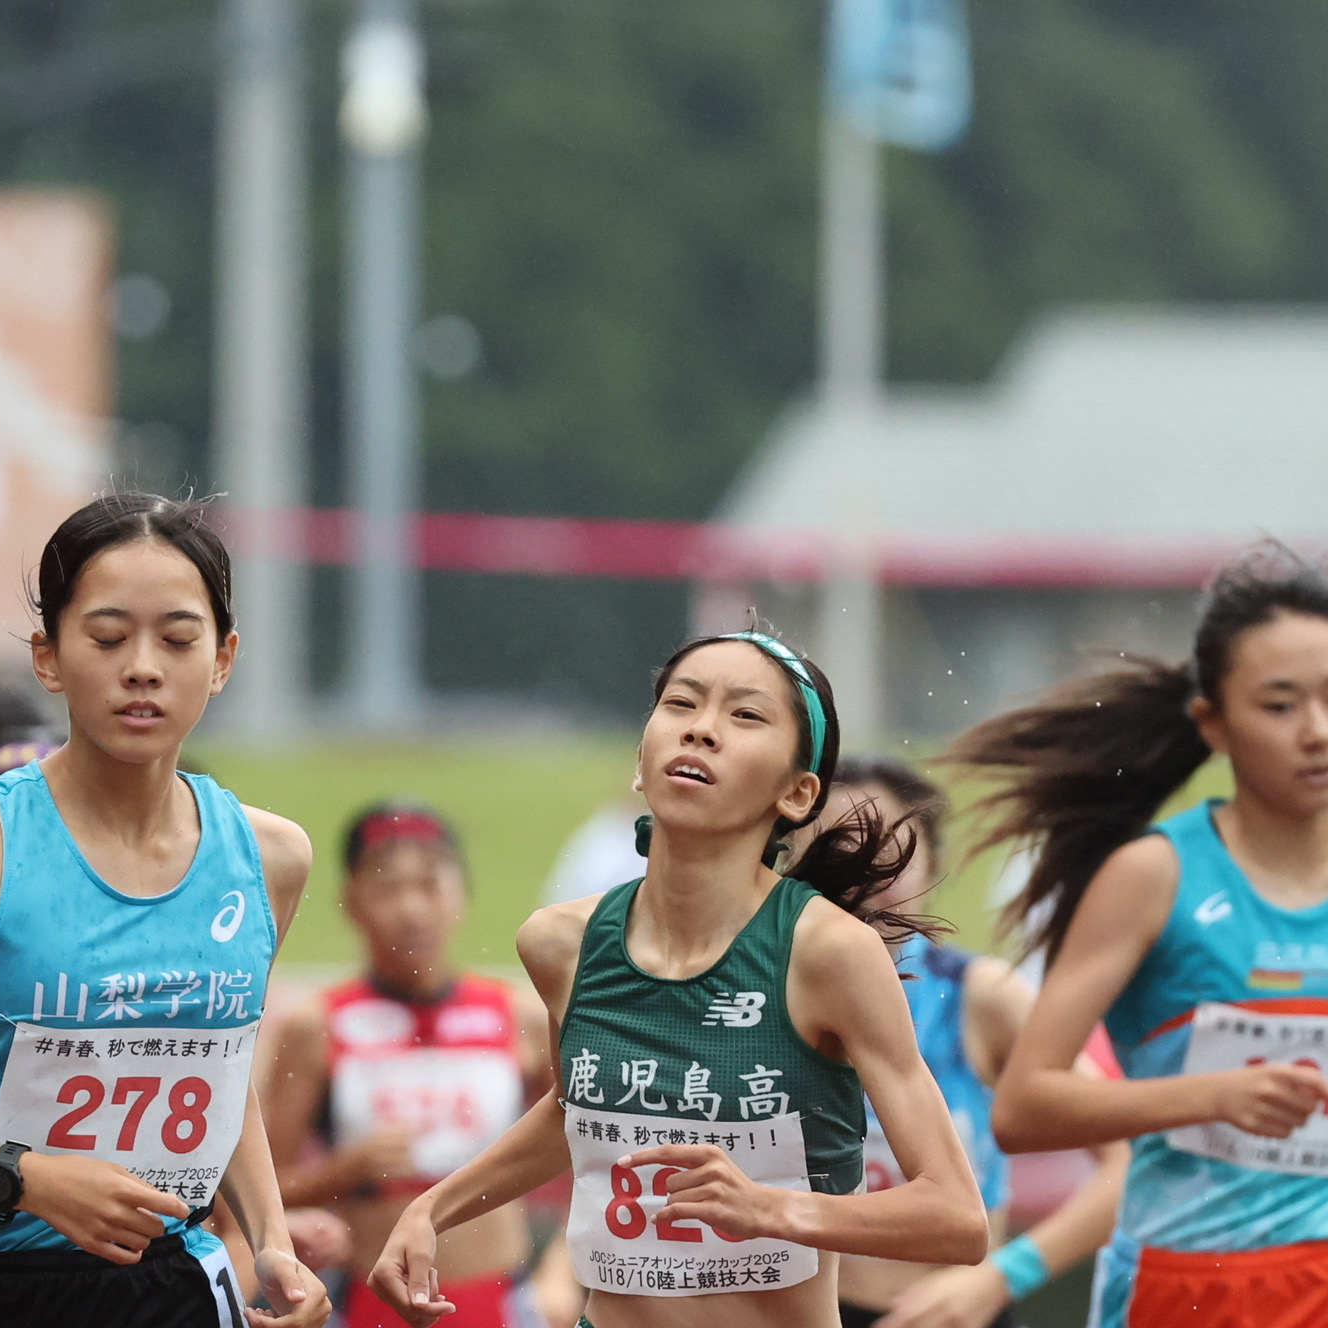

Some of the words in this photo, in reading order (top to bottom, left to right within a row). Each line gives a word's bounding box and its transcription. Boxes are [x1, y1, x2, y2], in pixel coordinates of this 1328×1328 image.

[32, 968, 253, 1022] 山梨学院
[45, 1074, 212, 1155] 278
[567, 1047, 791, 1123] 鹿児島高
[605, 1162, 752, 1243] 82
[589, 1249, 790, 1271] JOCジュニアオリンピックカップ2025
[598, 1263, 781, 1291] U18/16陸上競技大会
